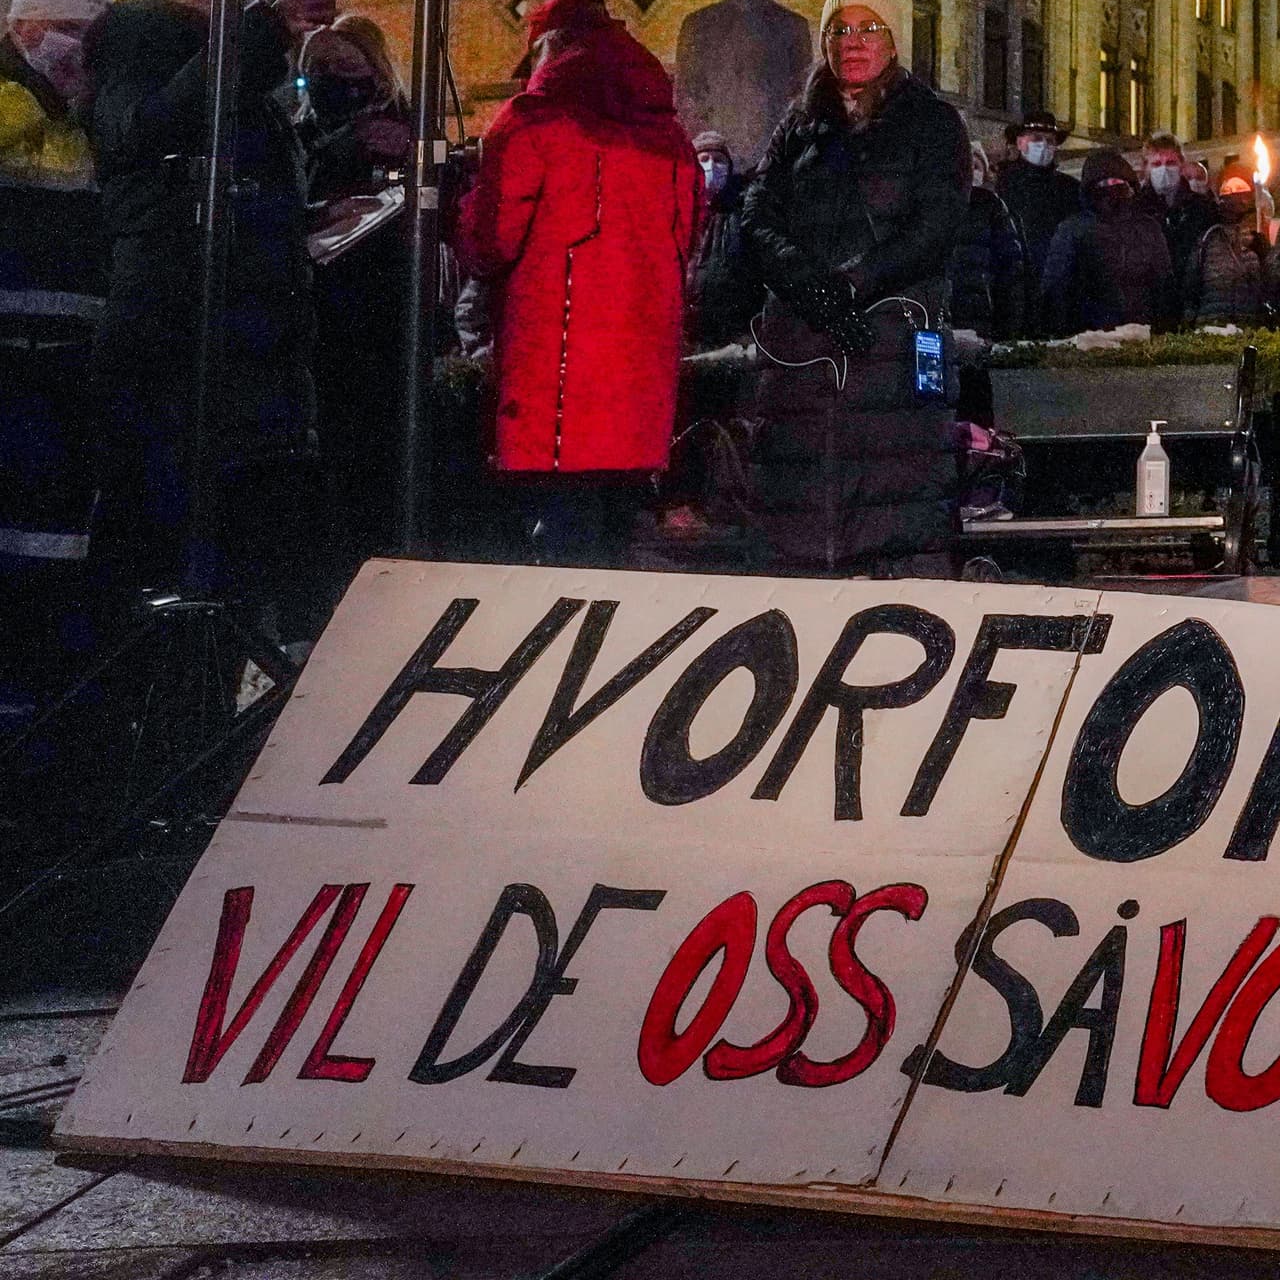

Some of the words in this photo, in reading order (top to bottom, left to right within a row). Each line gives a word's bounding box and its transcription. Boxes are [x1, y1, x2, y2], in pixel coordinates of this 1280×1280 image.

[181, 882, 415, 1086] VIL
[408, 882, 667, 1089] DE
[637, 879, 928, 1087] OSS
